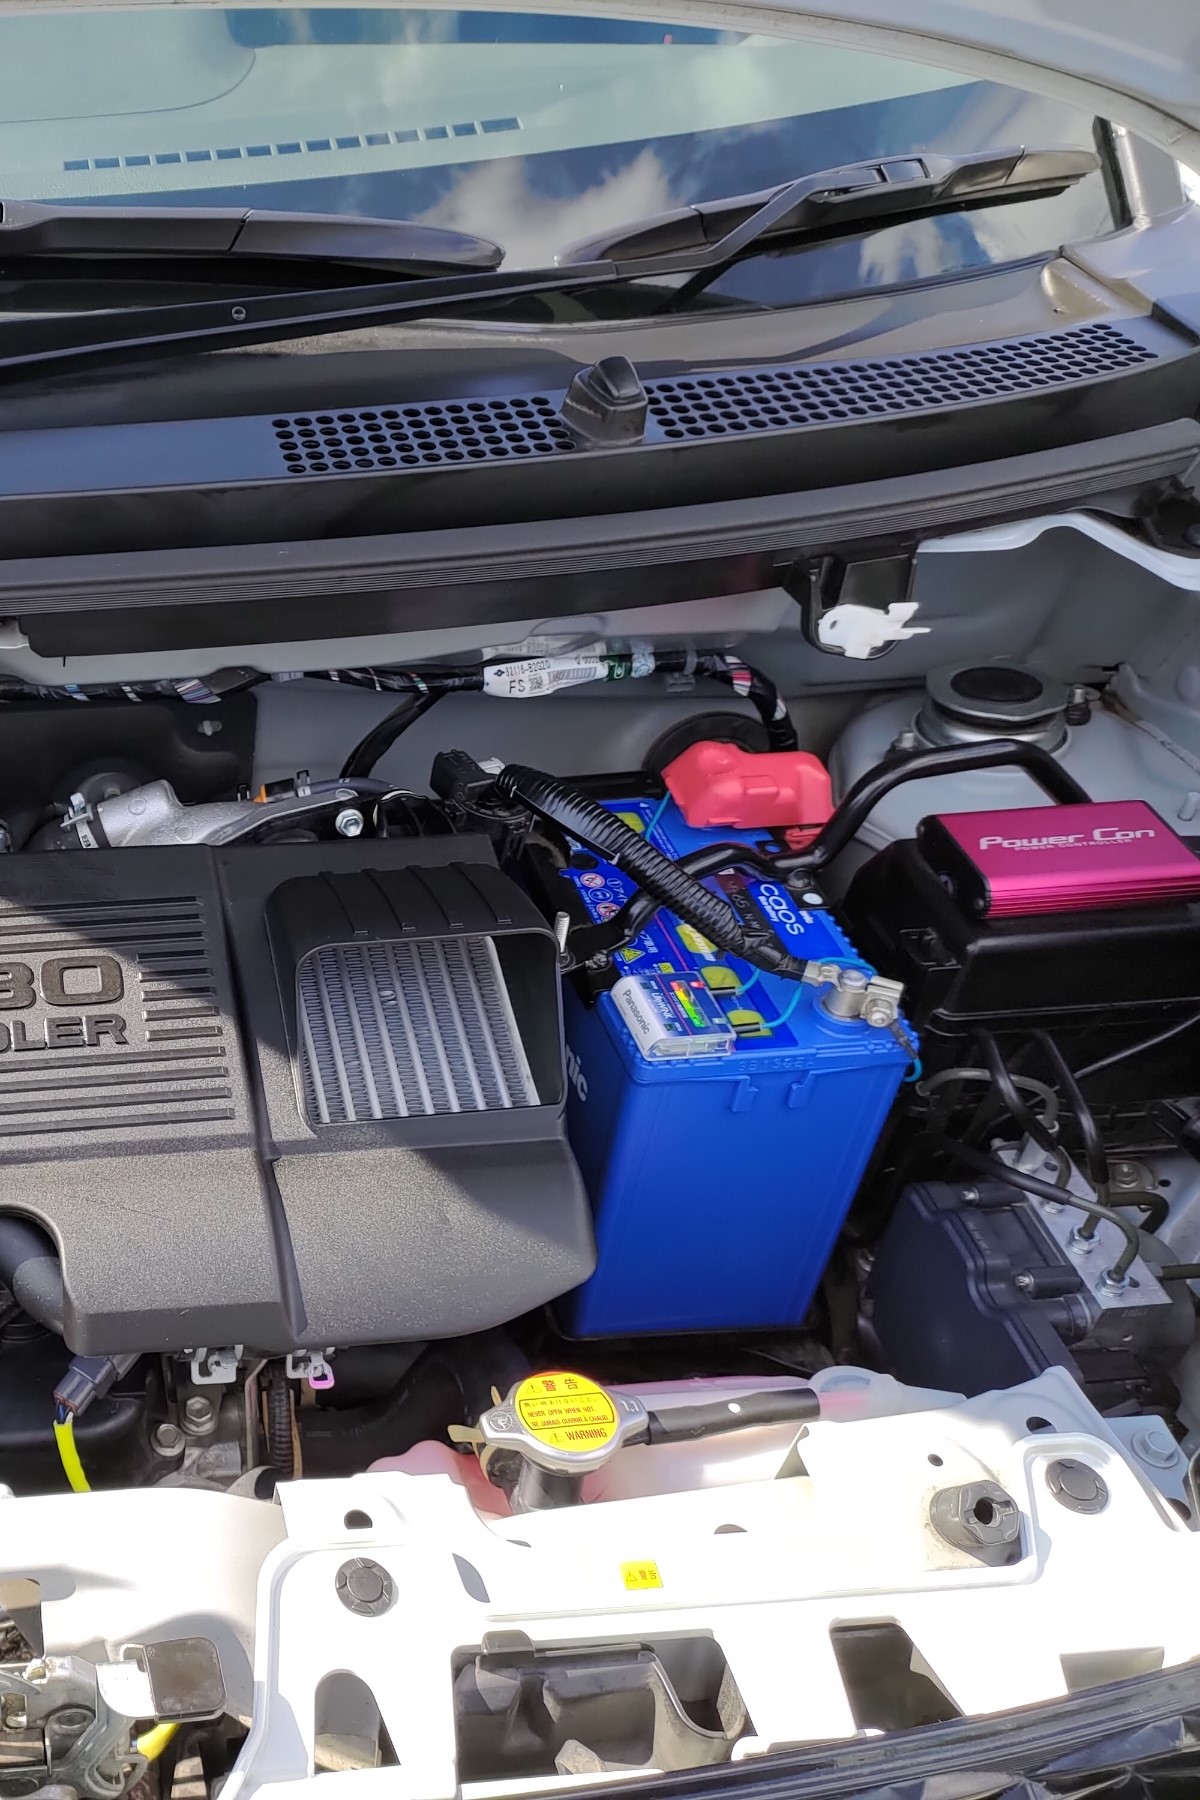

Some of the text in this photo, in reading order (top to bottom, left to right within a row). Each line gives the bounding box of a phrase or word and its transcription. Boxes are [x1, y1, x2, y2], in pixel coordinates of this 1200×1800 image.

[508, 679, 526, 693] FS
[979, 827, 1155, 850] Power Con
[1014, 838, 1133, 851] POWER CONTROLLER
[760, 883, 805, 935] caos
[622, 988, 651, 1035] Panasonic
[528, 1409, 545, 1418] NEVER
[548, 1408, 563, 1416] OPEN
[565, 1407, 581, 1415] WHEN
[565, 1427, 608, 1441] WARNING
